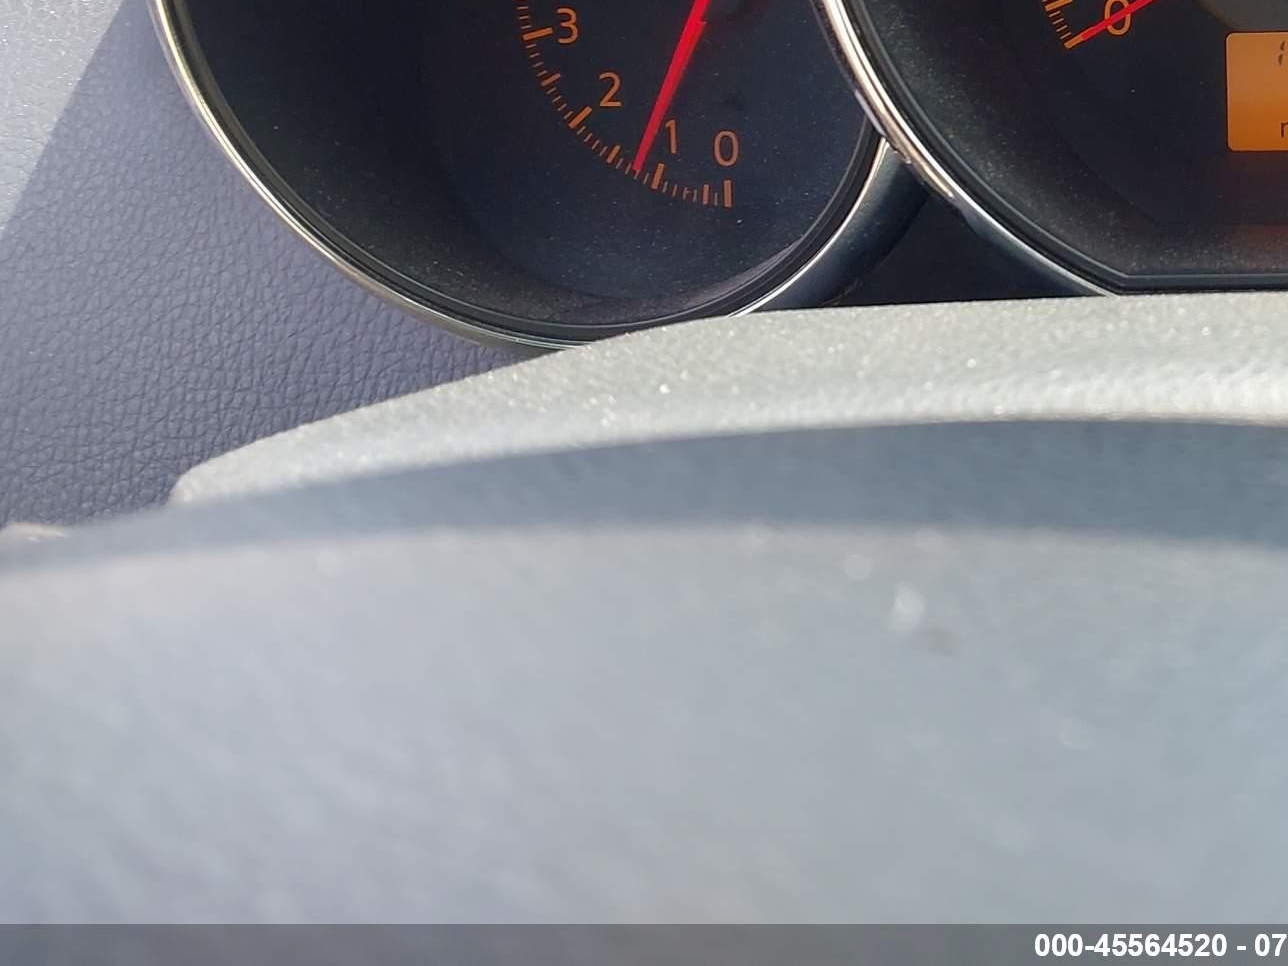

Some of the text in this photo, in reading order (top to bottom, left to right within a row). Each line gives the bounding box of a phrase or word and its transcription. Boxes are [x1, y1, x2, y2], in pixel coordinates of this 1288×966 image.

[559, 7, 578, 43] 3
[601, 73, 620, 107] 2
[664, 120, 679, 154] 1
[713, 130, 739, 166] 0
